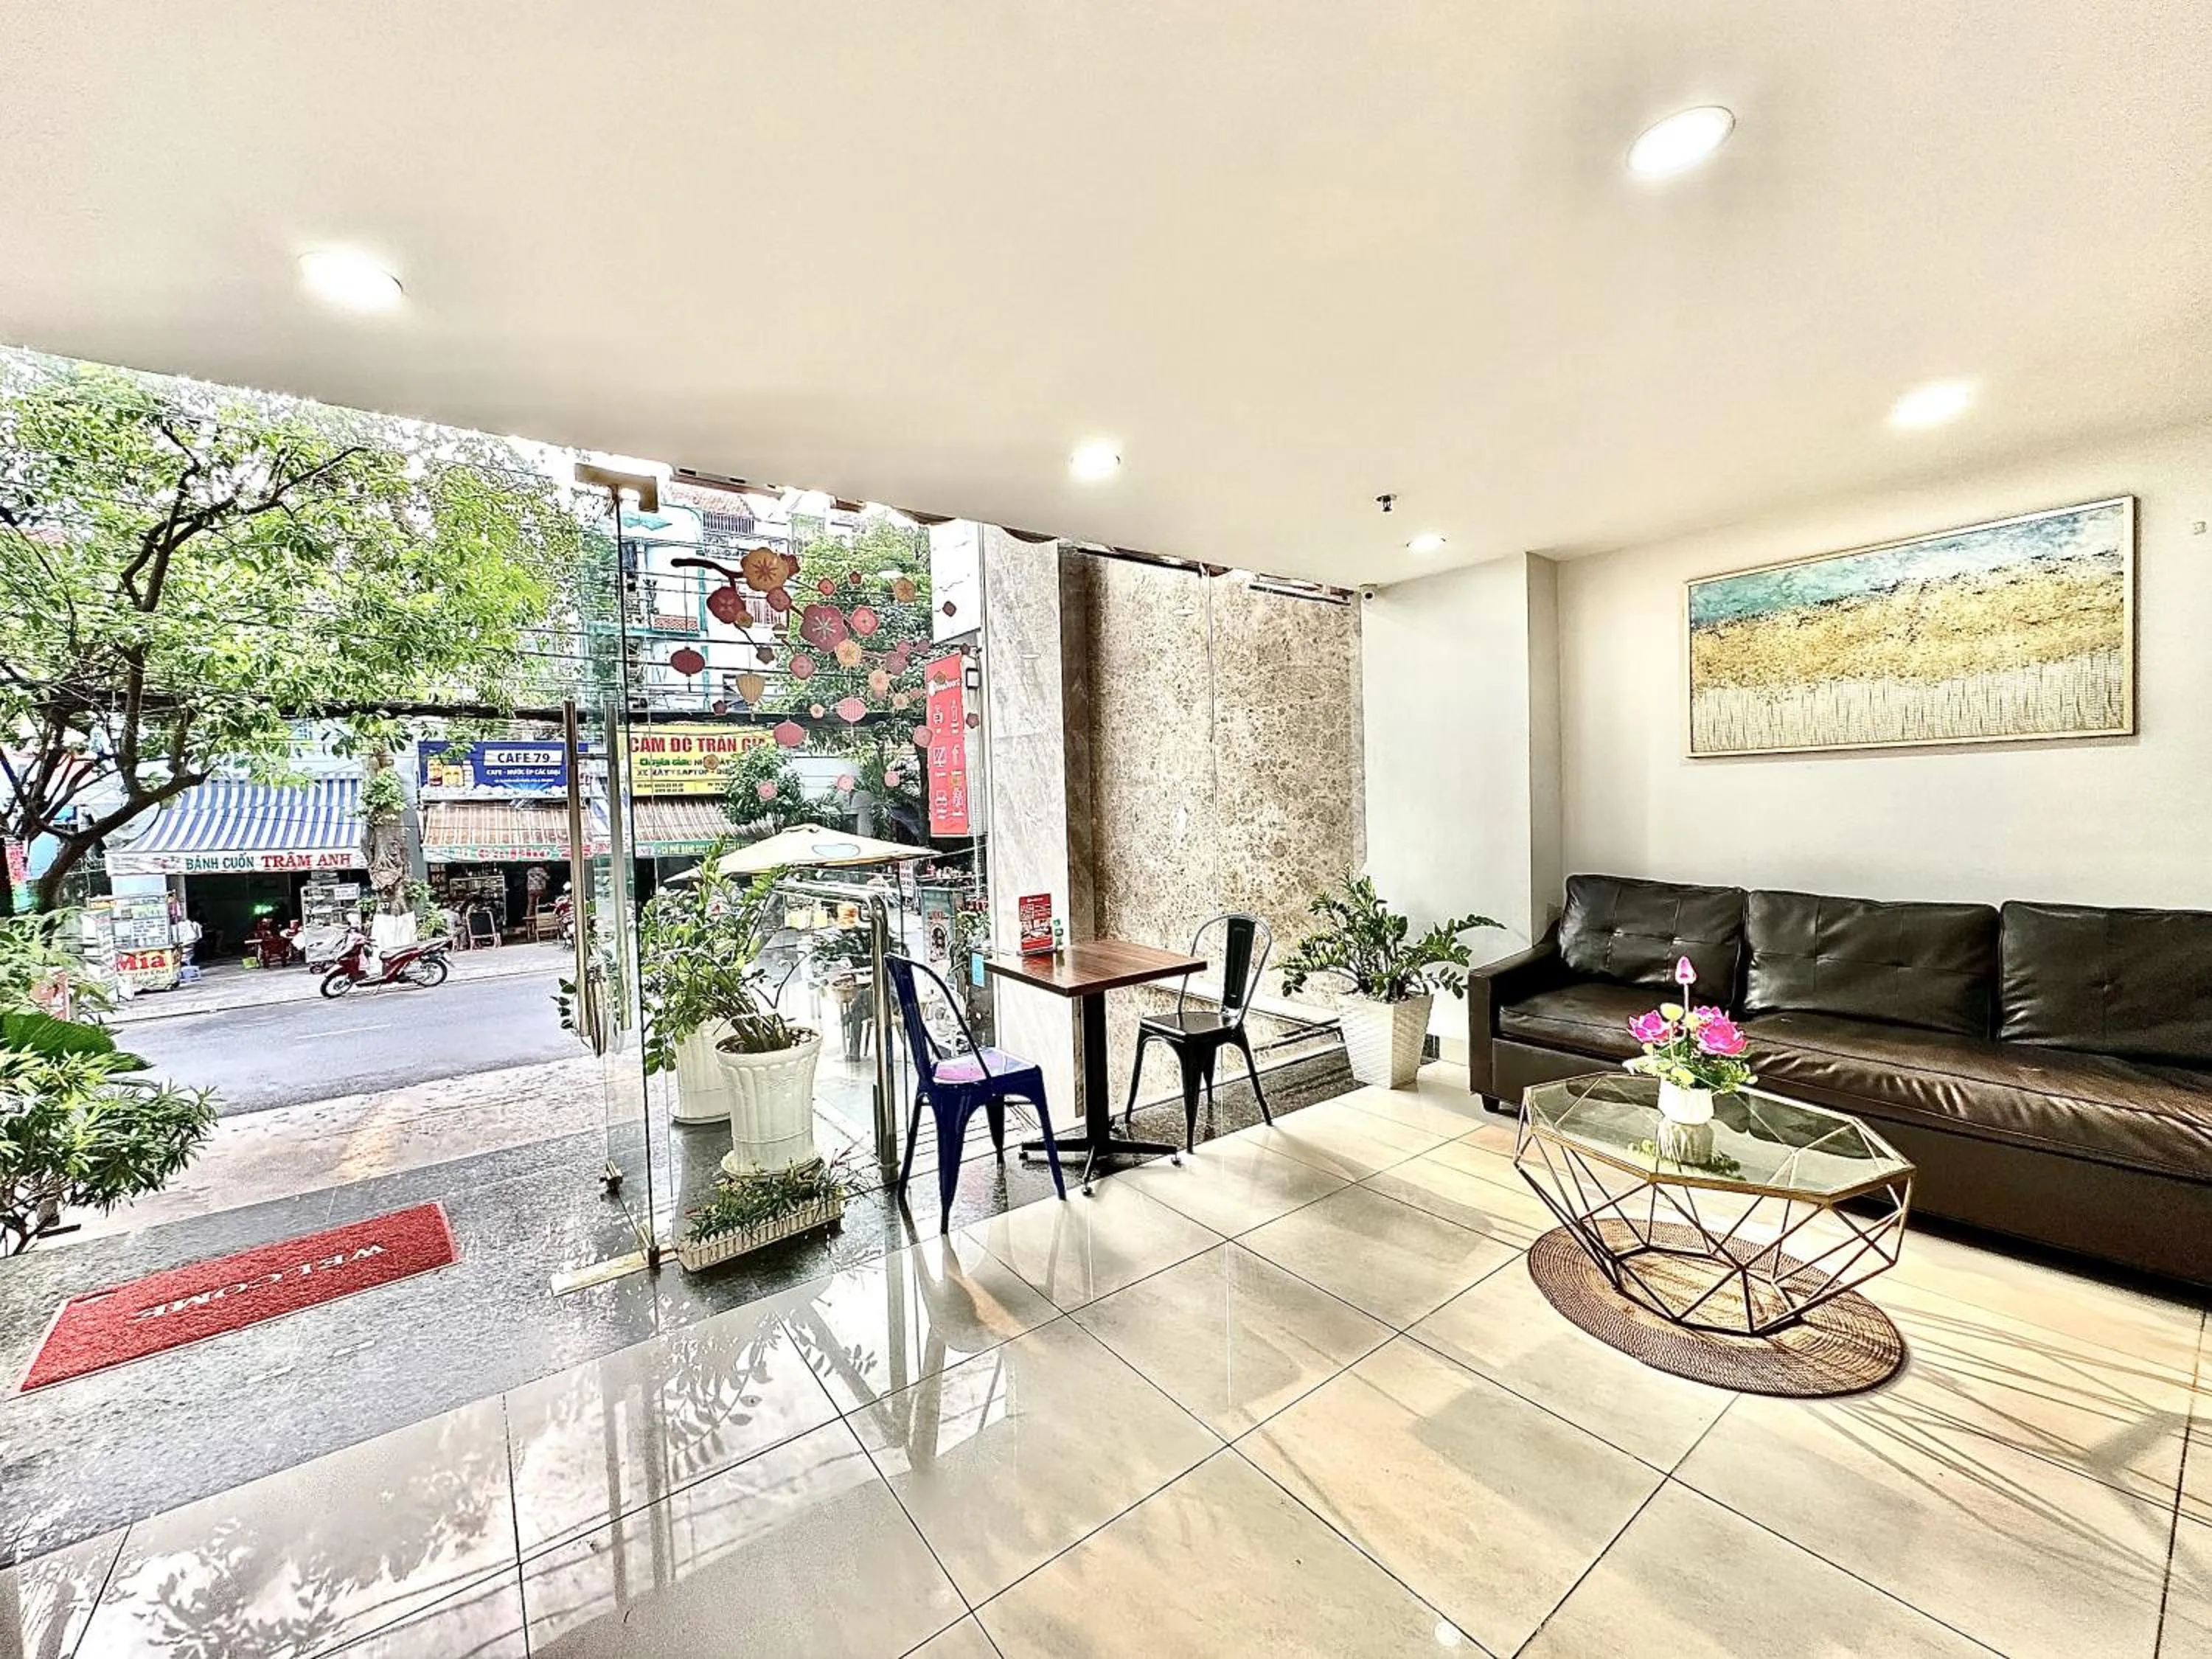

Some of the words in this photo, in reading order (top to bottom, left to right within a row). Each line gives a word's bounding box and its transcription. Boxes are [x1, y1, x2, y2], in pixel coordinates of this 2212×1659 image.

[497, 752, 532, 763] CAFE
[533, 752, 551, 763] 79
[186, 855, 219, 870] BÁNH
[222, 852, 254, 869] CUỐN
[260, 851, 311, 868] TRÂM
[316, 853, 352, 866] ANH
[133, 1243, 388, 1321] WELCOME
